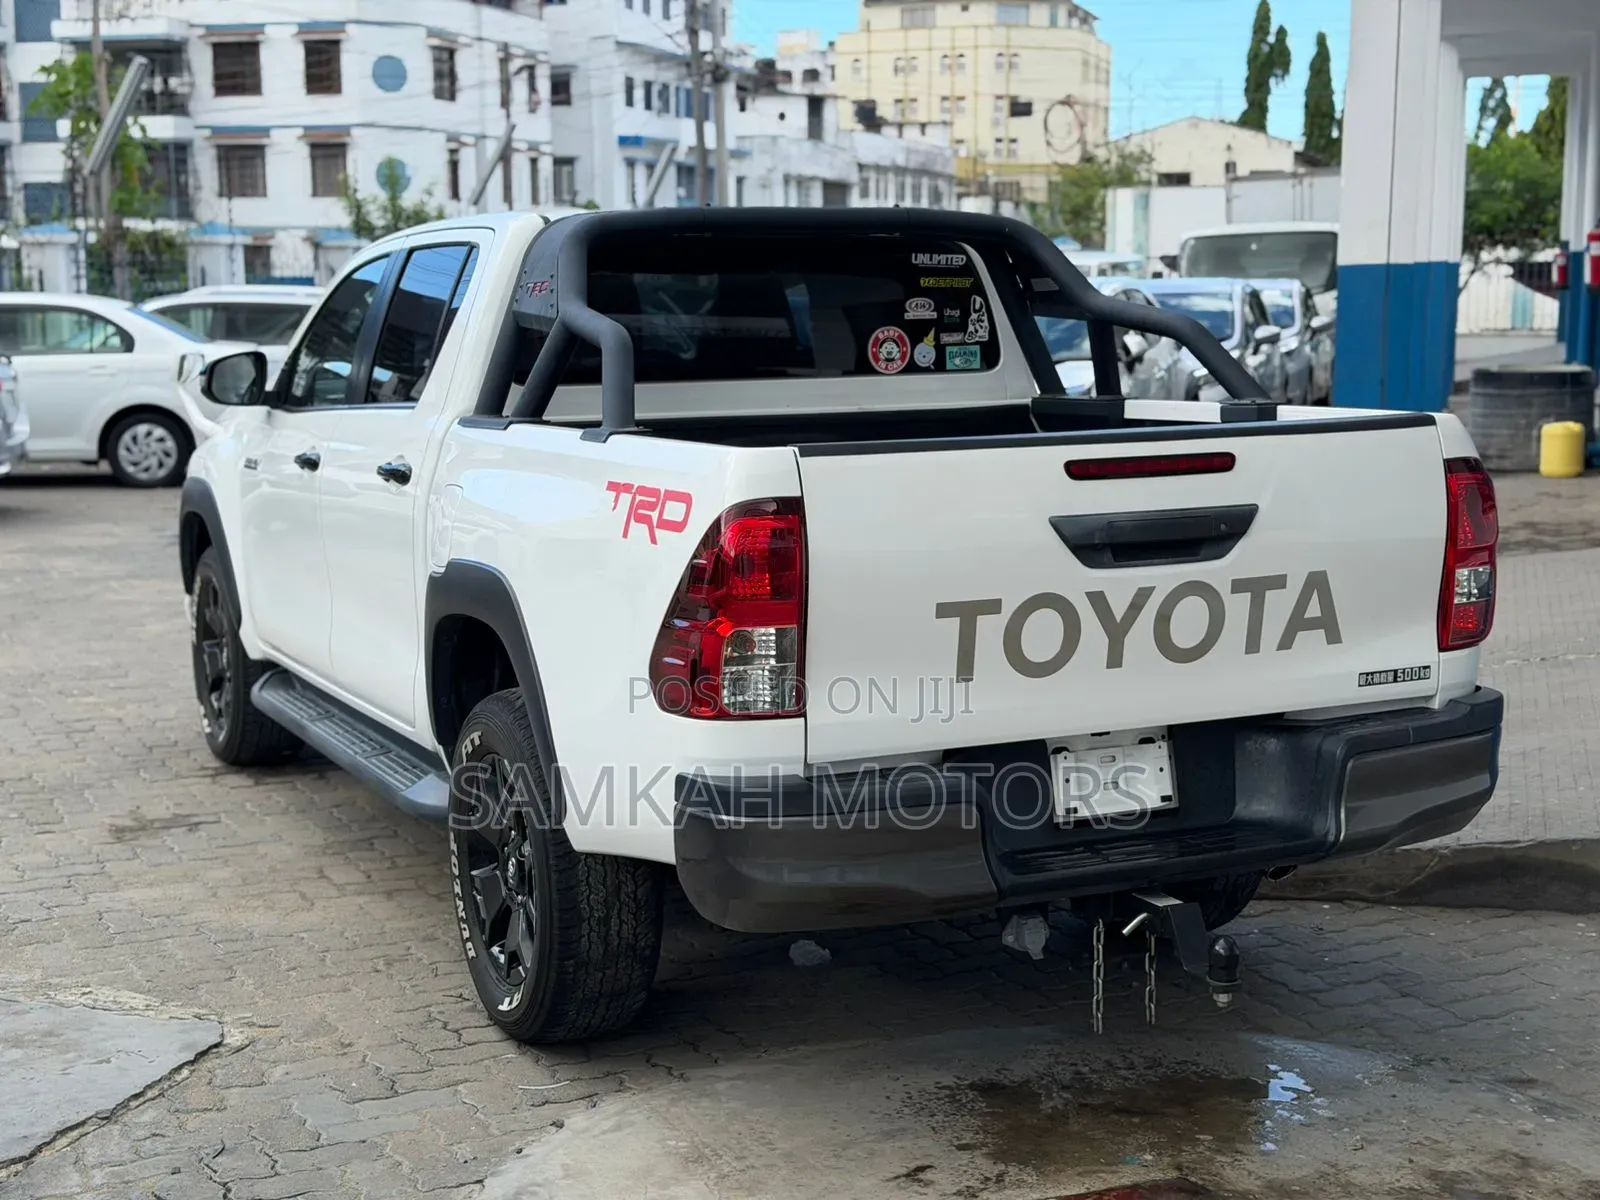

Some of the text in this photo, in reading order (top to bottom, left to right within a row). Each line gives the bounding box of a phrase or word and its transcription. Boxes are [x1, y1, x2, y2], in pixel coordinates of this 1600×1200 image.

[911, 252, 967, 266] UNLIMITED
[878, 330, 900, 339] BABY
[887, 359, 903, 370] CAR
[605, 480, 693, 545] TRD
[935, 570, 1343, 684] TOYOTA
[449, 831, 476, 959] DUNLOP
